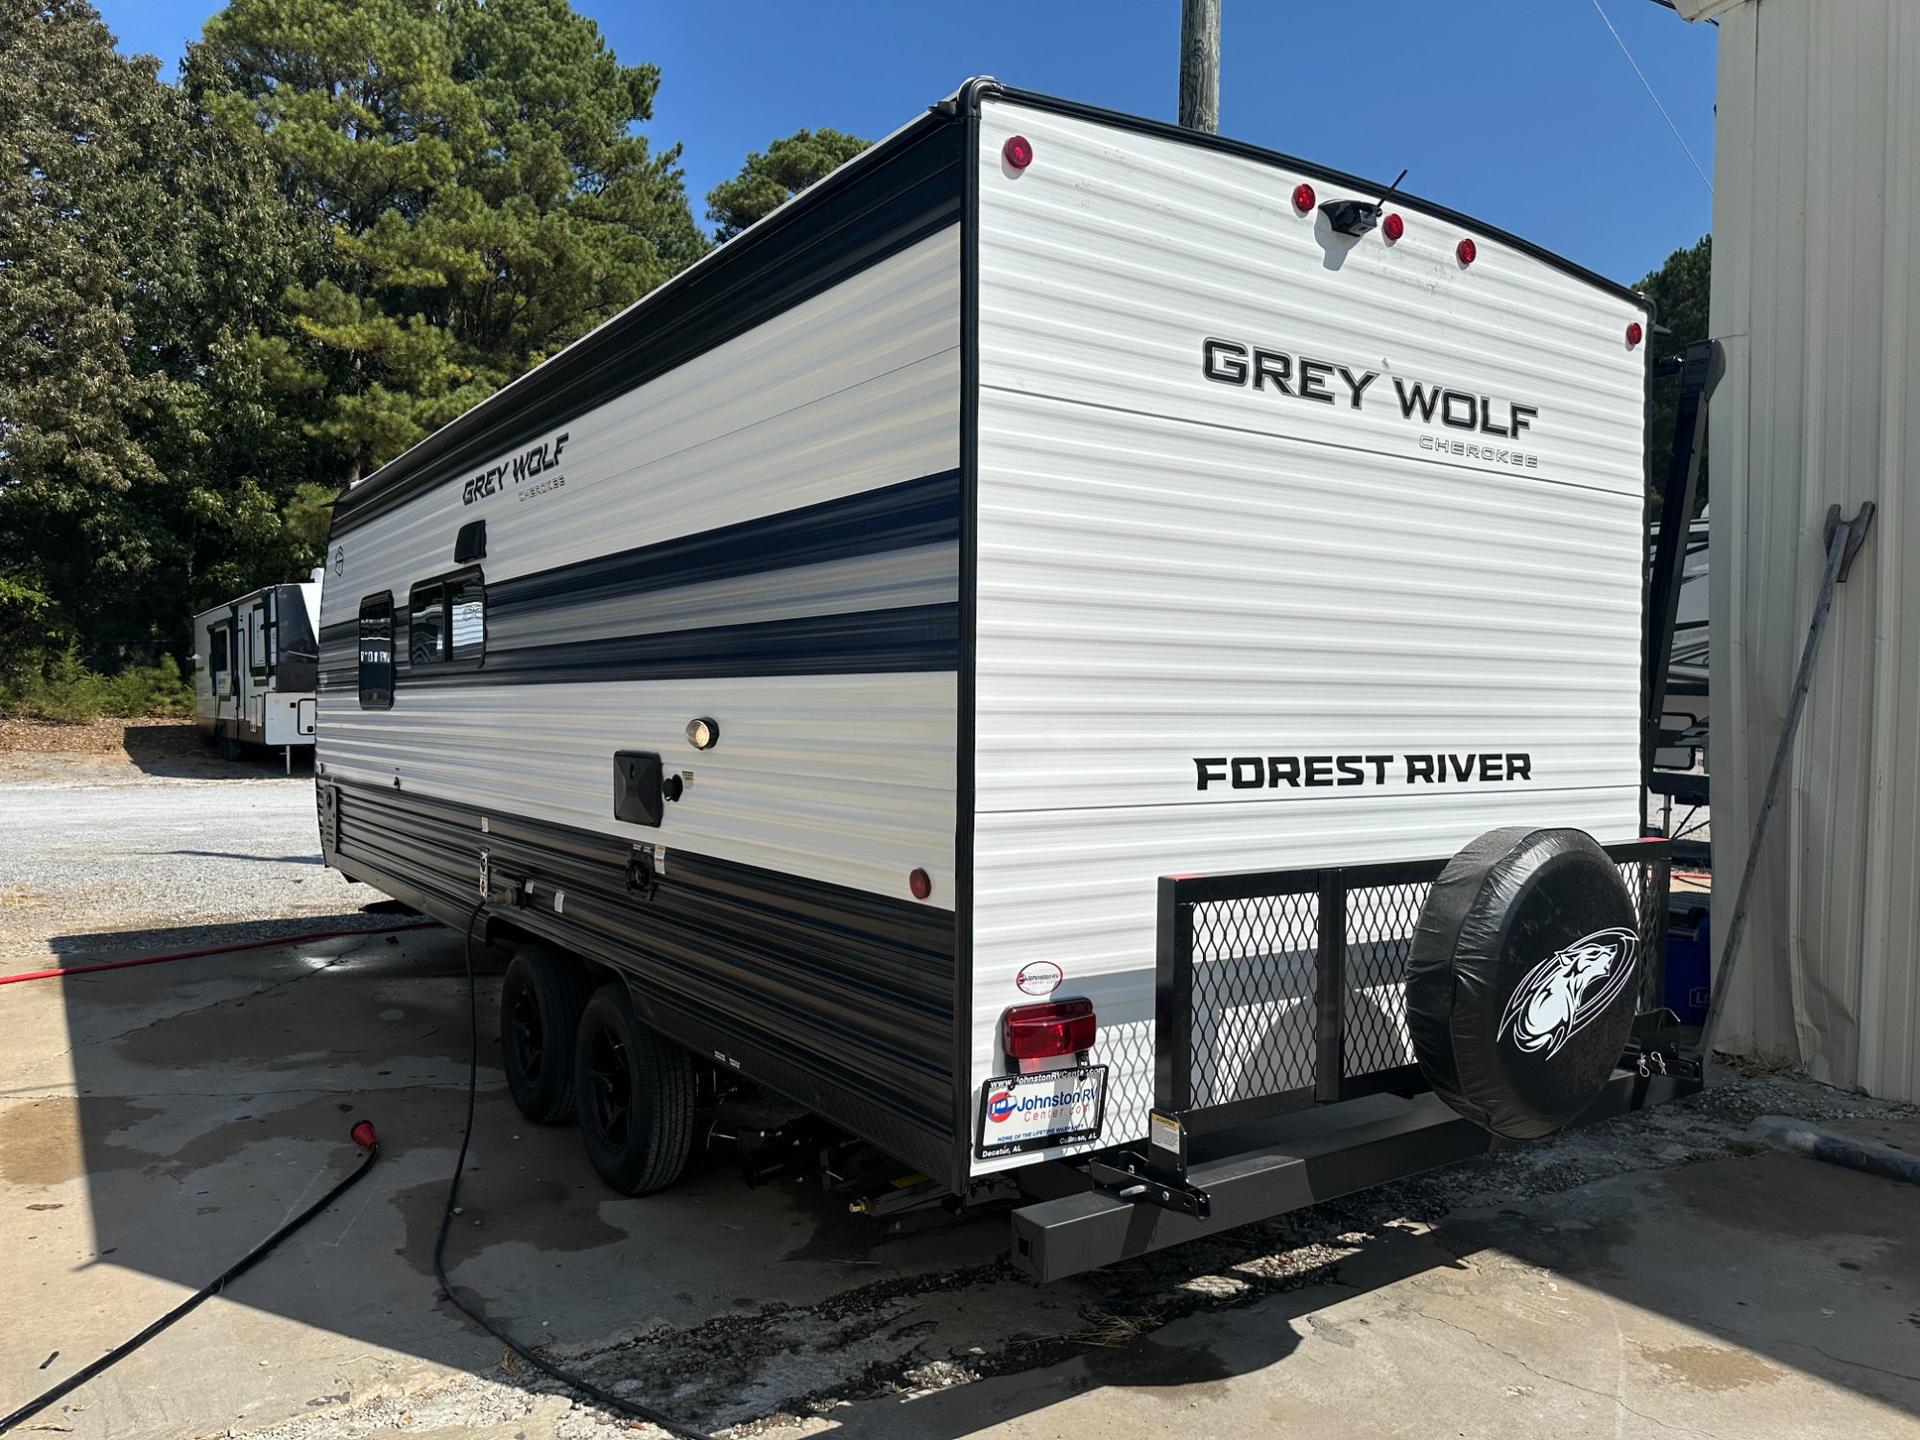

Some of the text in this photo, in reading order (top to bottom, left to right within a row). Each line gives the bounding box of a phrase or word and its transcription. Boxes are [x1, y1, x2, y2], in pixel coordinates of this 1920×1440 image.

[1203, 337, 1538, 439] GREY WOLF
[462, 432, 569, 506] GREY WOLF
[1419, 435, 1538, 468] CHEROKEE
[1193, 753, 1532, 791] FOREST RIVER
[1017, 1087, 1098, 1111] Johnston RV
[997, 1134, 1013, 1142] HOME
[1033, 1127, 1055, 1136] LIFETIME
